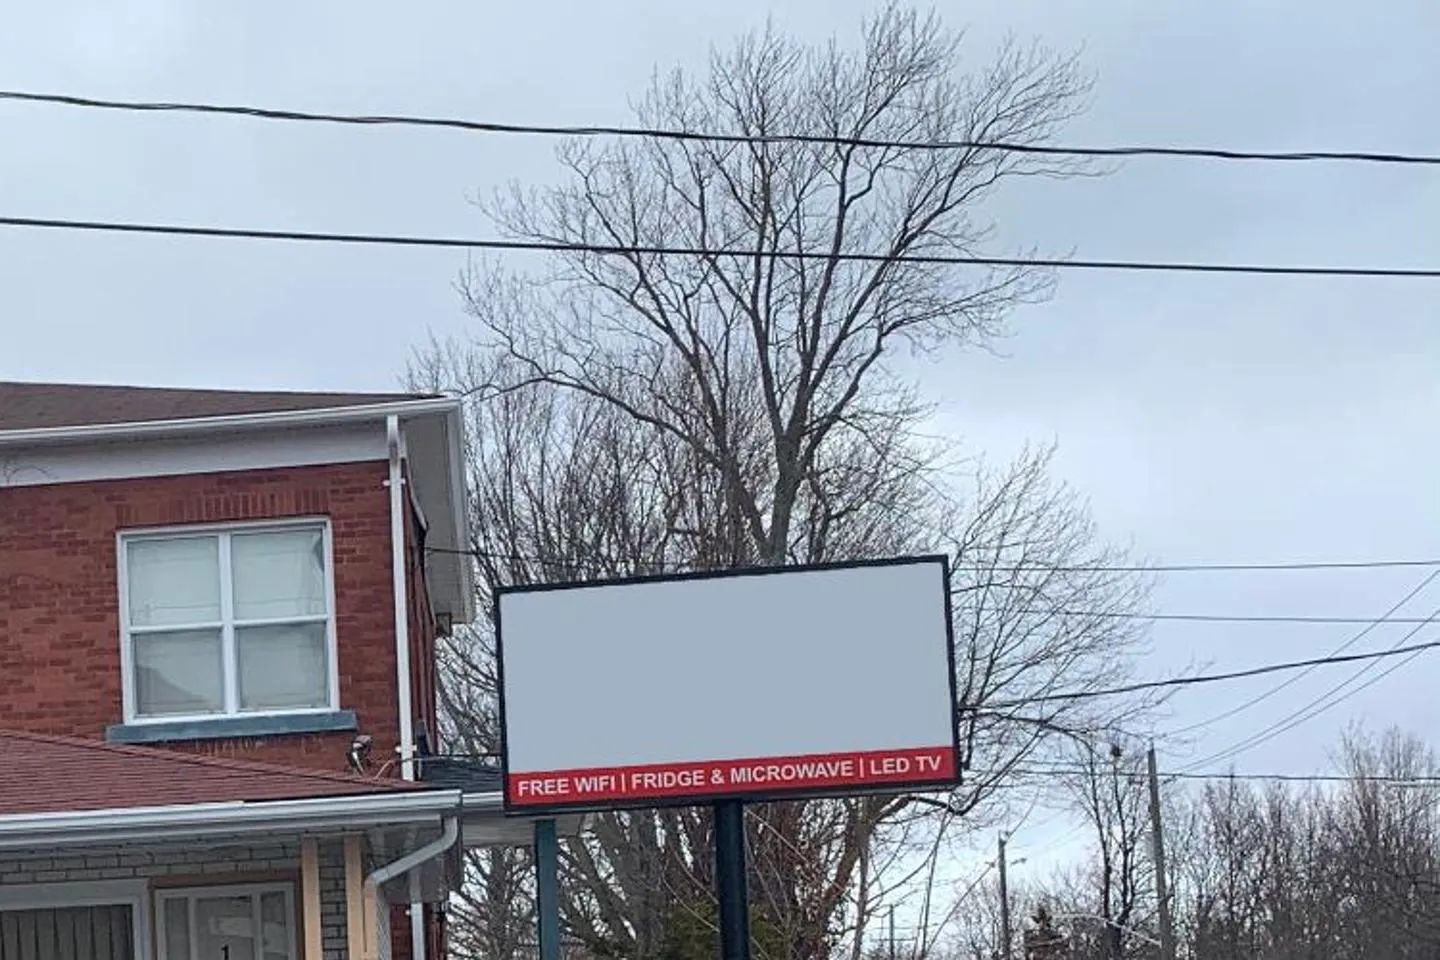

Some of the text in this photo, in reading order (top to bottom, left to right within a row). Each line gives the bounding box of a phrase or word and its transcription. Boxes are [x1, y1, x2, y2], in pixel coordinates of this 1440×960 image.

[518, 778, 570, 797] FREE
[574, 775, 616, 793] WIFI
[631, 770, 705, 789] FRIDGE
[710, 768, 725, 784] &
[730, 760, 854, 784] MICROWAVE
[870, 757, 910, 775] LED
[915, 756, 942, 772] TV
